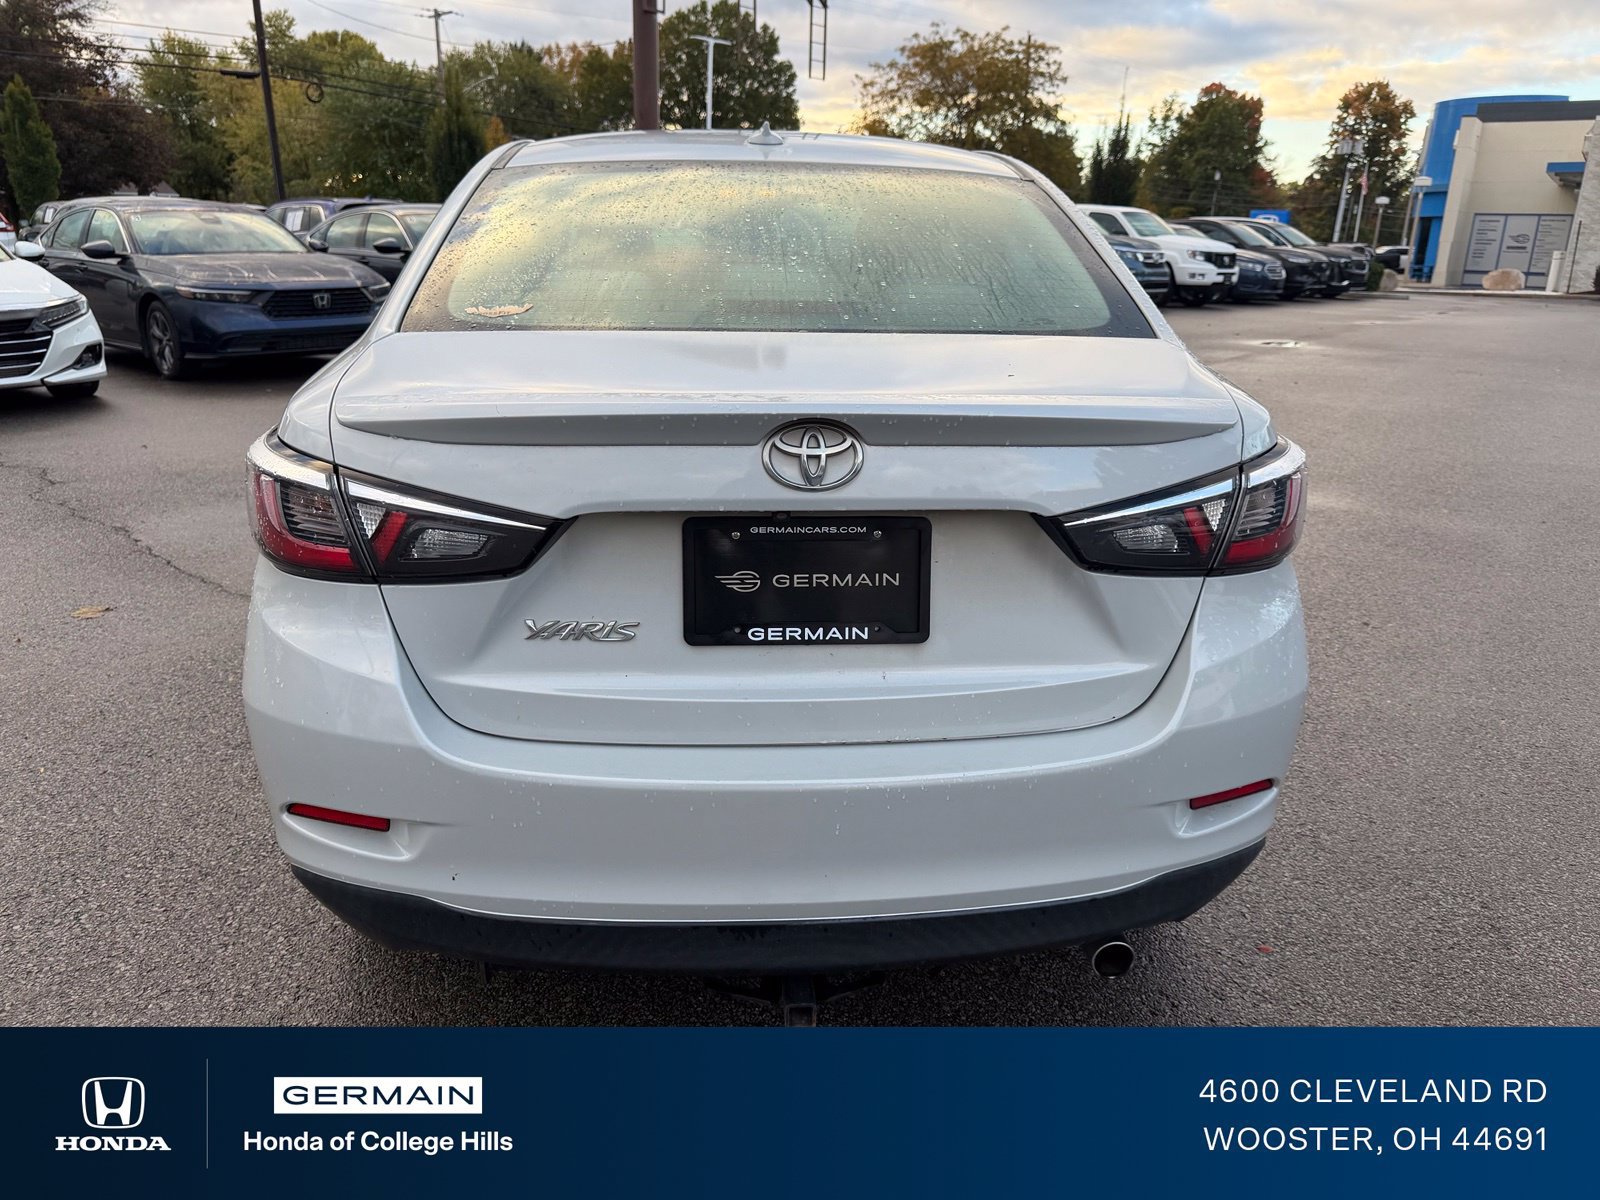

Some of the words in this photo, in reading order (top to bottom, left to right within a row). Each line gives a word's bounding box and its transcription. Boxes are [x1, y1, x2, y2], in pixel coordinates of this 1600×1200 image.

[749, 526, 867, 534] GERMAINCARS.COM
[772, 572, 901, 588] GERMAIN
[524, 619, 640, 642] YARIS
[747, 626, 869, 642] GERMAIN
